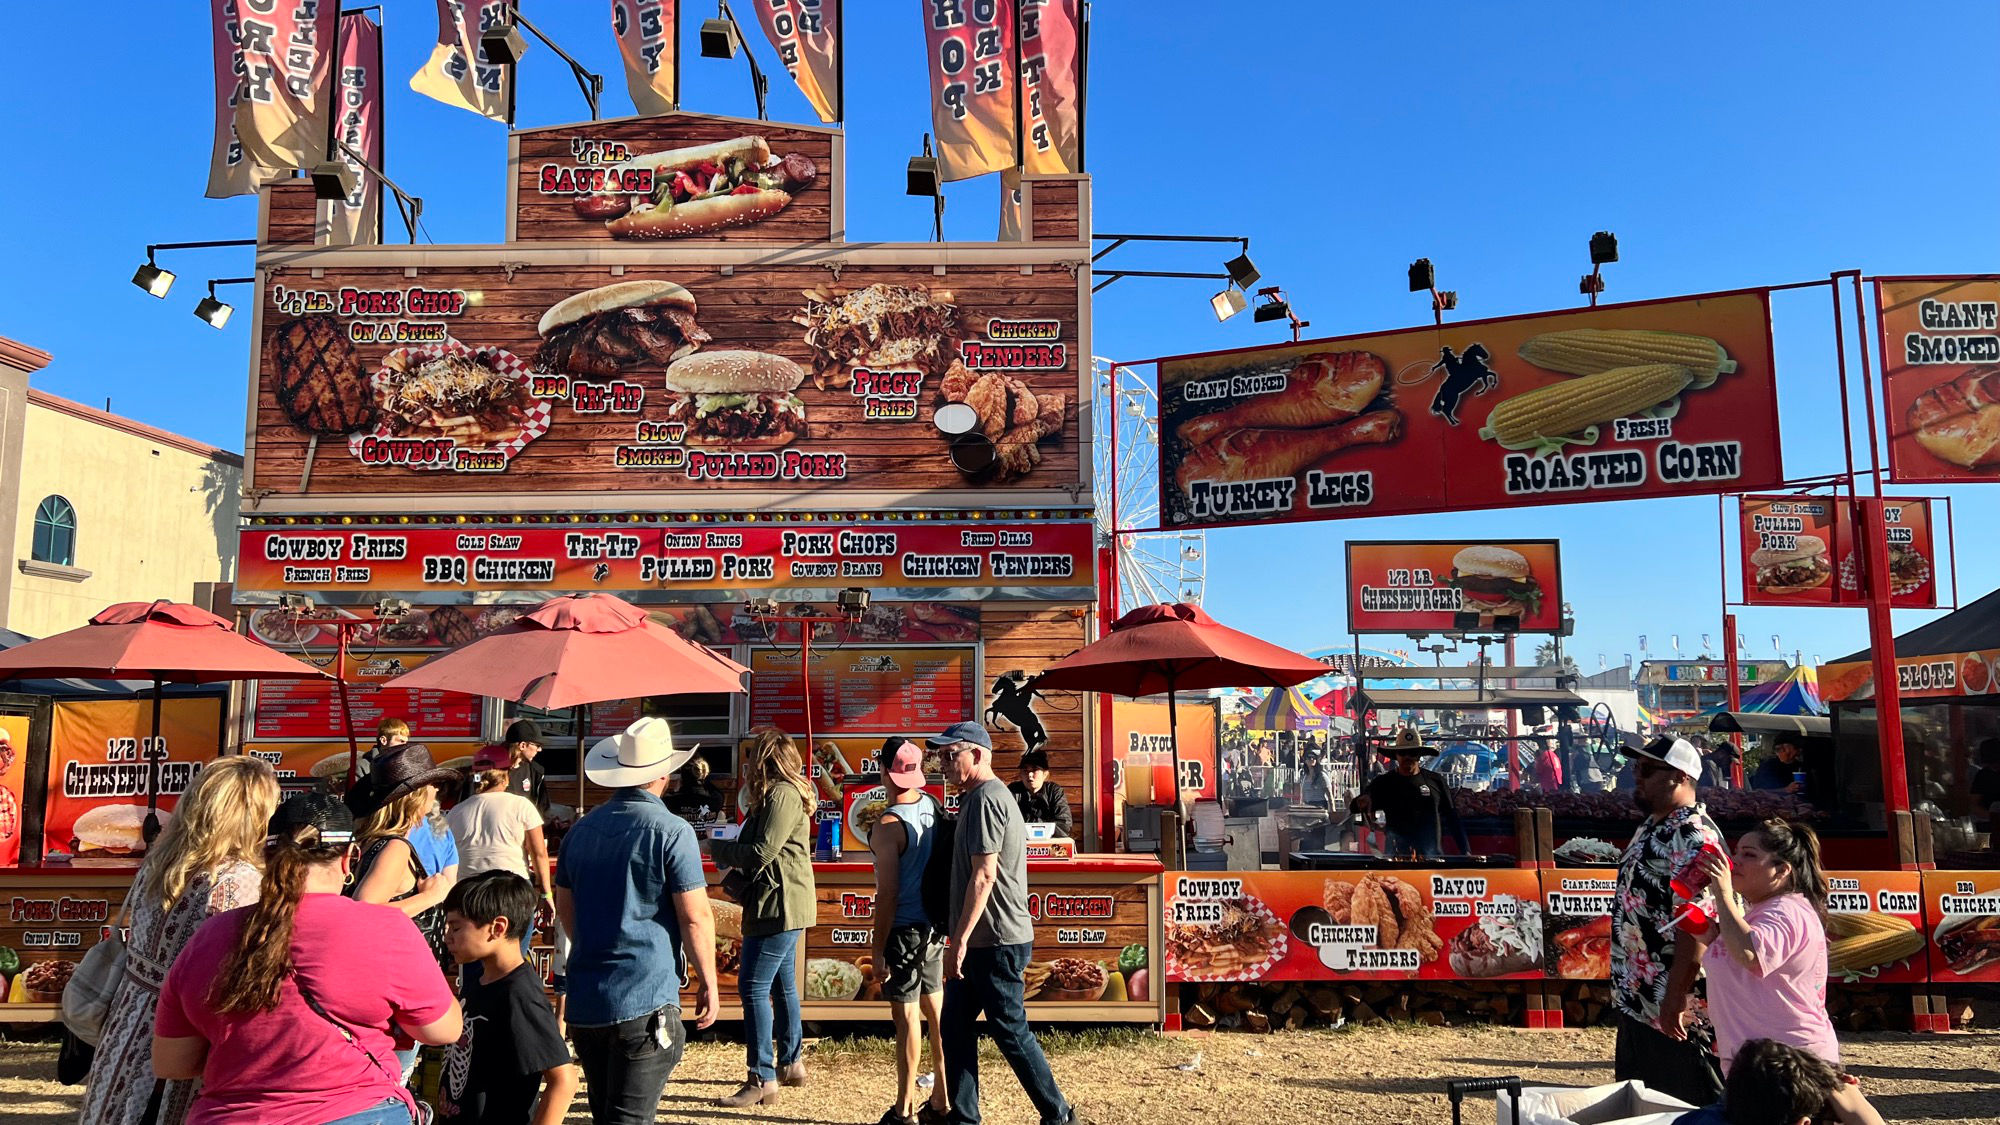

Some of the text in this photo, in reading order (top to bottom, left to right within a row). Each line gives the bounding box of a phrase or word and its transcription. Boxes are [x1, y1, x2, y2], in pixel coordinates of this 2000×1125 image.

[602, 141, 632, 162] LB.
[540, 165, 653, 193] SAUSAGE
[306, 291, 333, 311] LB.
[340, 288, 401, 315] PORK
[407, 288, 465, 314] CHOP
[1921, 300, 1997, 330] GIANT
[351, 322, 446, 341] ON A STICK
[989, 320, 1059, 339] CHICKEN
[962, 342, 1065, 369] TENDERS
[1906, 334, 2000, 364] SMOKED
[853, 369, 922, 396] PIGGY
[1185, 373, 1286, 401] GIANT SMOKED
[532, 376, 643, 411] BBQ TRI-TIP
[866, 399, 916, 417] FRIES
[638, 422, 685, 442] SLOW
[1615, 418, 1671, 440] FRESH
[362, 437, 506, 470] COWBOY FRIES
[616, 447, 845, 478] SMOKED PULLED PORK
[1506, 442, 1739, 493] ROASTED CORN
[1190, 471, 1373, 517] TURKEY LEGS
[1771, 503, 1790, 513] SLOW
[1754, 515, 1802, 531] PULLED
[457, 535, 521, 550] COLE SLAW
[665, 533, 742, 548] ONION RINGS
[783, 532, 896, 555] PORK CHOPS
[961, 531, 1032, 546] FRIED DILLS
[1760, 532, 1797, 549] PORK
[1886, 527, 1912, 542] RIES
[266, 535, 406, 559] COWBOY FRIES
[567, 533, 639, 558] TRI-TIP
[285, 567, 369, 582] FRENCH FRIES
[424, 557, 554, 584] BBQ CHICKEN
[641, 555, 773, 579] PULLED PORK
[791, 561, 883, 577] COWBOY BEANS
[903, 552, 1073, 577] CHICKEN TENDERS
[1388, 570, 1409, 585] 1/2
[1362, 586, 1462, 611] CHEESEBURGERS
[108, 738, 136, 760] 1/2
[1178, 878, 1241, 898] COWBOY
[1432, 877, 1486, 896] BAYOU
[1562, 879, 1617, 891] GIANT SMOKE
[1829, 878, 1859, 889] FRESH
[1957, 882, 1975, 894] BBQ
[11, 897, 108, 921] PORK CHOPS
[1046, 893, 1114, 918] CHICKEN
[1434, 901, 1515, 915] BAKED POTATO
[1879, 891, 1918, 911] CORN
[1941, 895, 2000, 914] CHICKE
[1175, 903, 1221, 921] FRIES
[24, 931, 80, 945] ONION RINGS
[832, 929, 867, 943] COWBOY
[1058, 928, 1106, 943] COLE SLAW
[1310, 925, 1376, 944] CHICKEN
[1346, 949, 1418, 968] TENDERS
